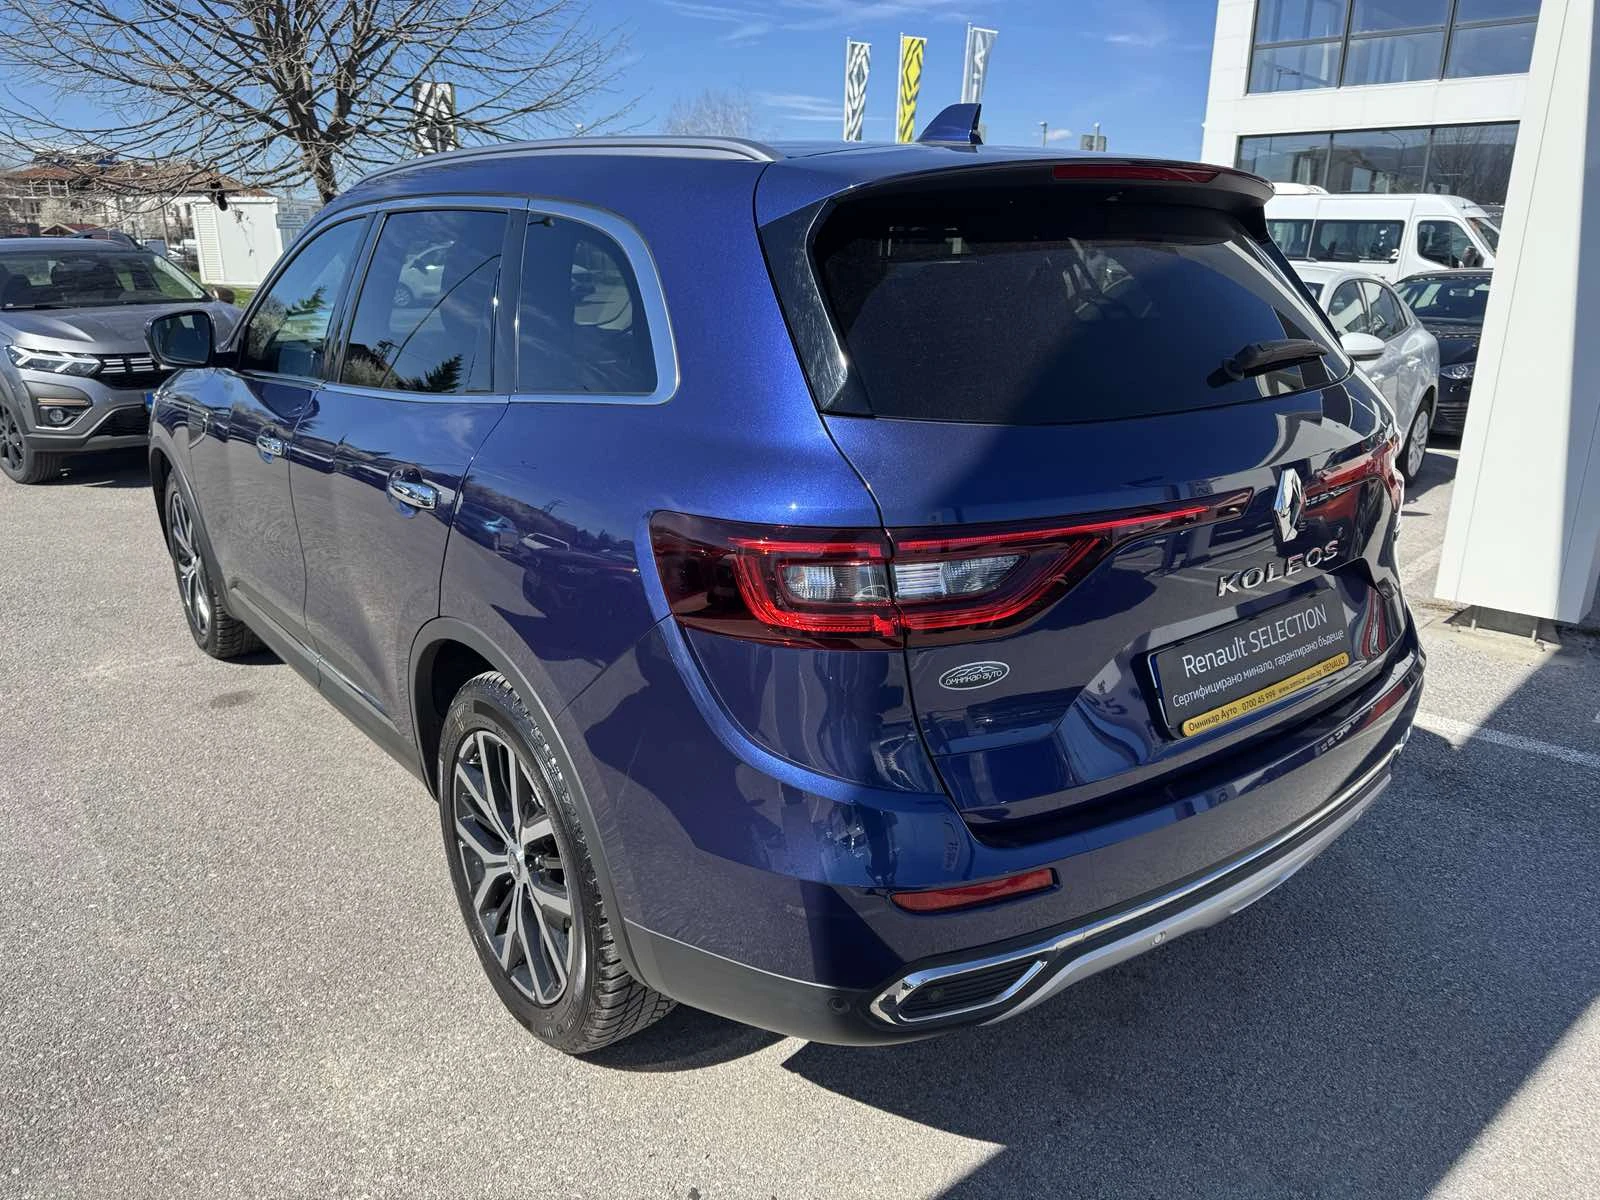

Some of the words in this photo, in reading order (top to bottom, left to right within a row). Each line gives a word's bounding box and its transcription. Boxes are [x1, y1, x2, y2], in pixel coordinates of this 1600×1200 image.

[1218, 540, 1339, 597] KOLEOS
[1172, 673, 1243, 708] Сертифицирано
[1243, 660, 1275, 680] минало,
[1274, 641, 1318, 667] гарантирано
[1318, 629, 1345, 647] бъдеще
[1182, 636, 1249, 678] Renault
[1249, 604, 1328, 653] SELECTION
[1188, 714, 1220, 732] Омникар
[1220, 706, 1238, 720] Ауто
[1242, 698, 1257, 711] 0700
[1322, 655, 1346, 673] RENAULT
